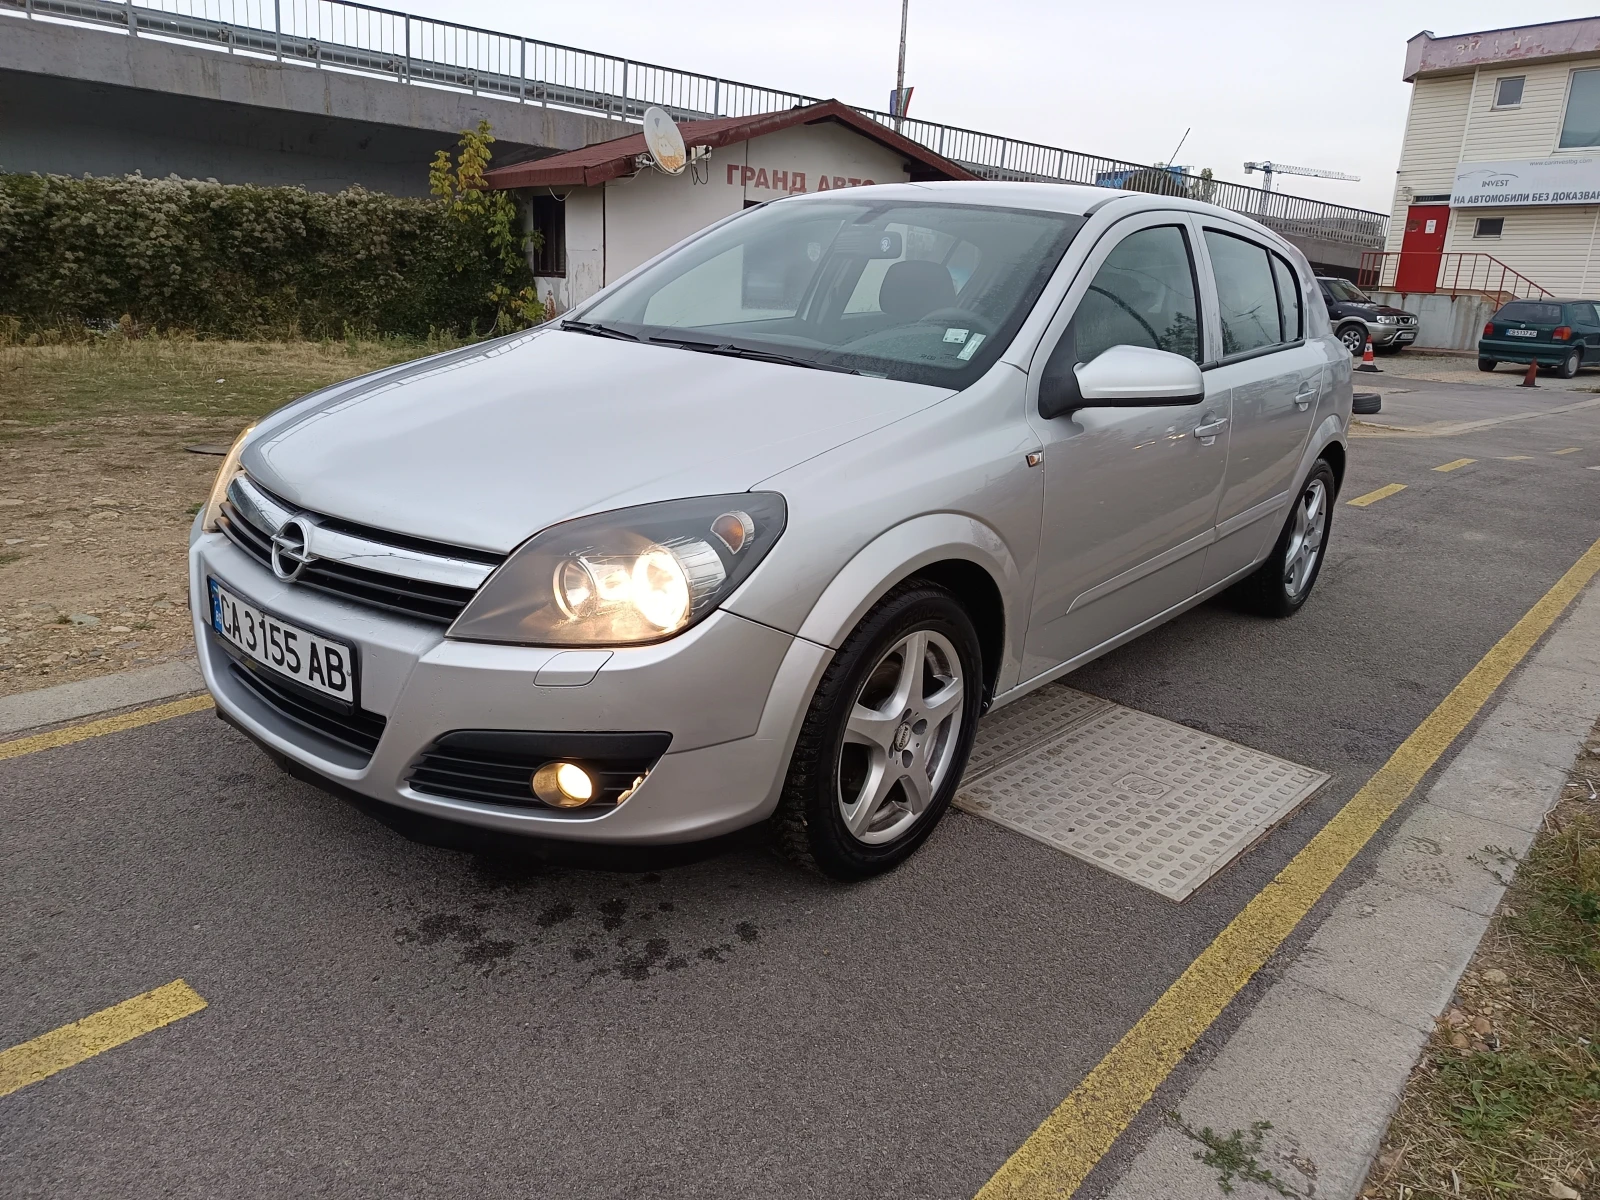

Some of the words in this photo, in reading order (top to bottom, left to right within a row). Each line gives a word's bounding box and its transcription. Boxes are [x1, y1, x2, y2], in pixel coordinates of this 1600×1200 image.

[726, 163, 807, 194] ГРАНД
[817, 174, 876, 193] АВТ
[1481, 180, 1509, 188] INVEST
[1453, 195, 1465, 205] НА
[1467, 193, 1530, 204] АВТОМОБИЛИ
[1531, 192, 1550, 202] БЕЗ
[220, 594, 243, 644] CA
[244, 610, 301, 674] 3155
[308, 641, 347, 692] AB
